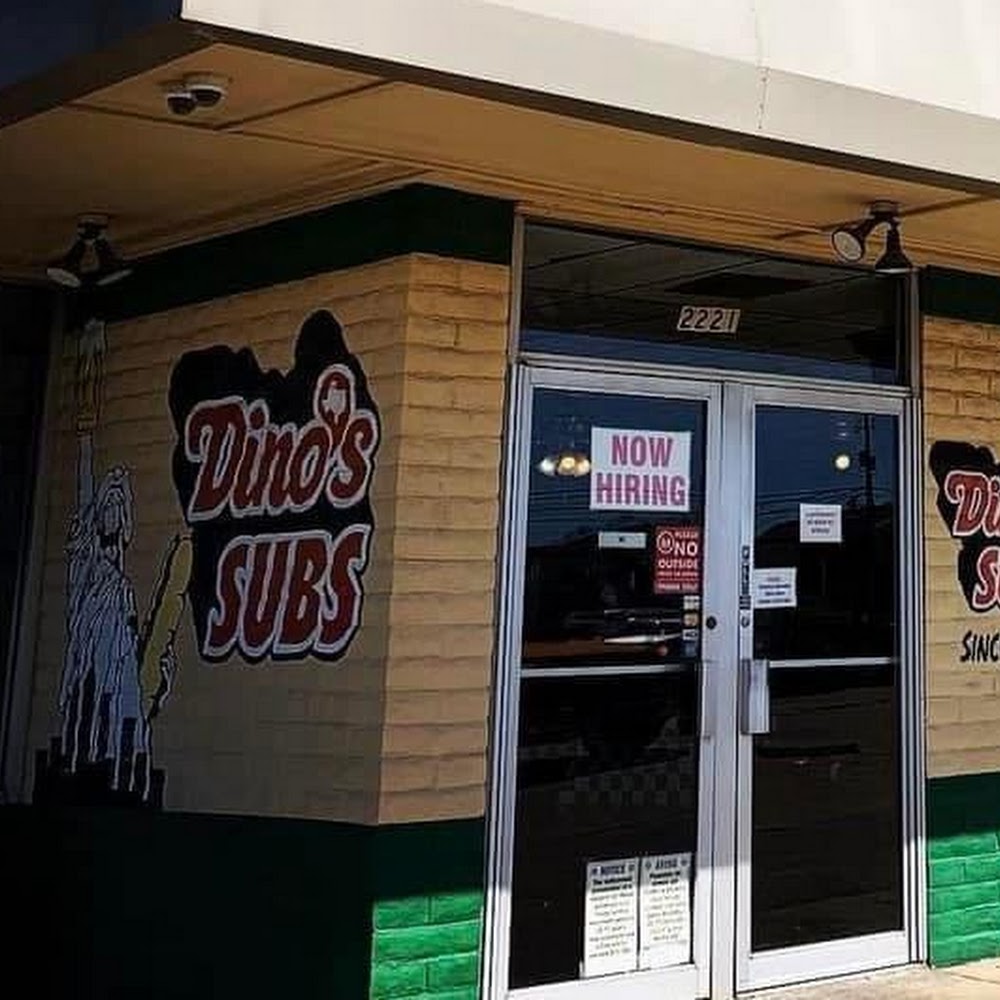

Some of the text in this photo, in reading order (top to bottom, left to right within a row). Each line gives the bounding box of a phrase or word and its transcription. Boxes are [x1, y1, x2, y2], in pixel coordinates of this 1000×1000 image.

[679, 308, 737, 333] 2221
[185, 364, 378, 521] Dino's
[611, 434, 673, 467] NOW
[595, 472, 686, 506] HIRING
[674, 541, 698, 557] NO
[203, 524, 371, 655] SUBS
